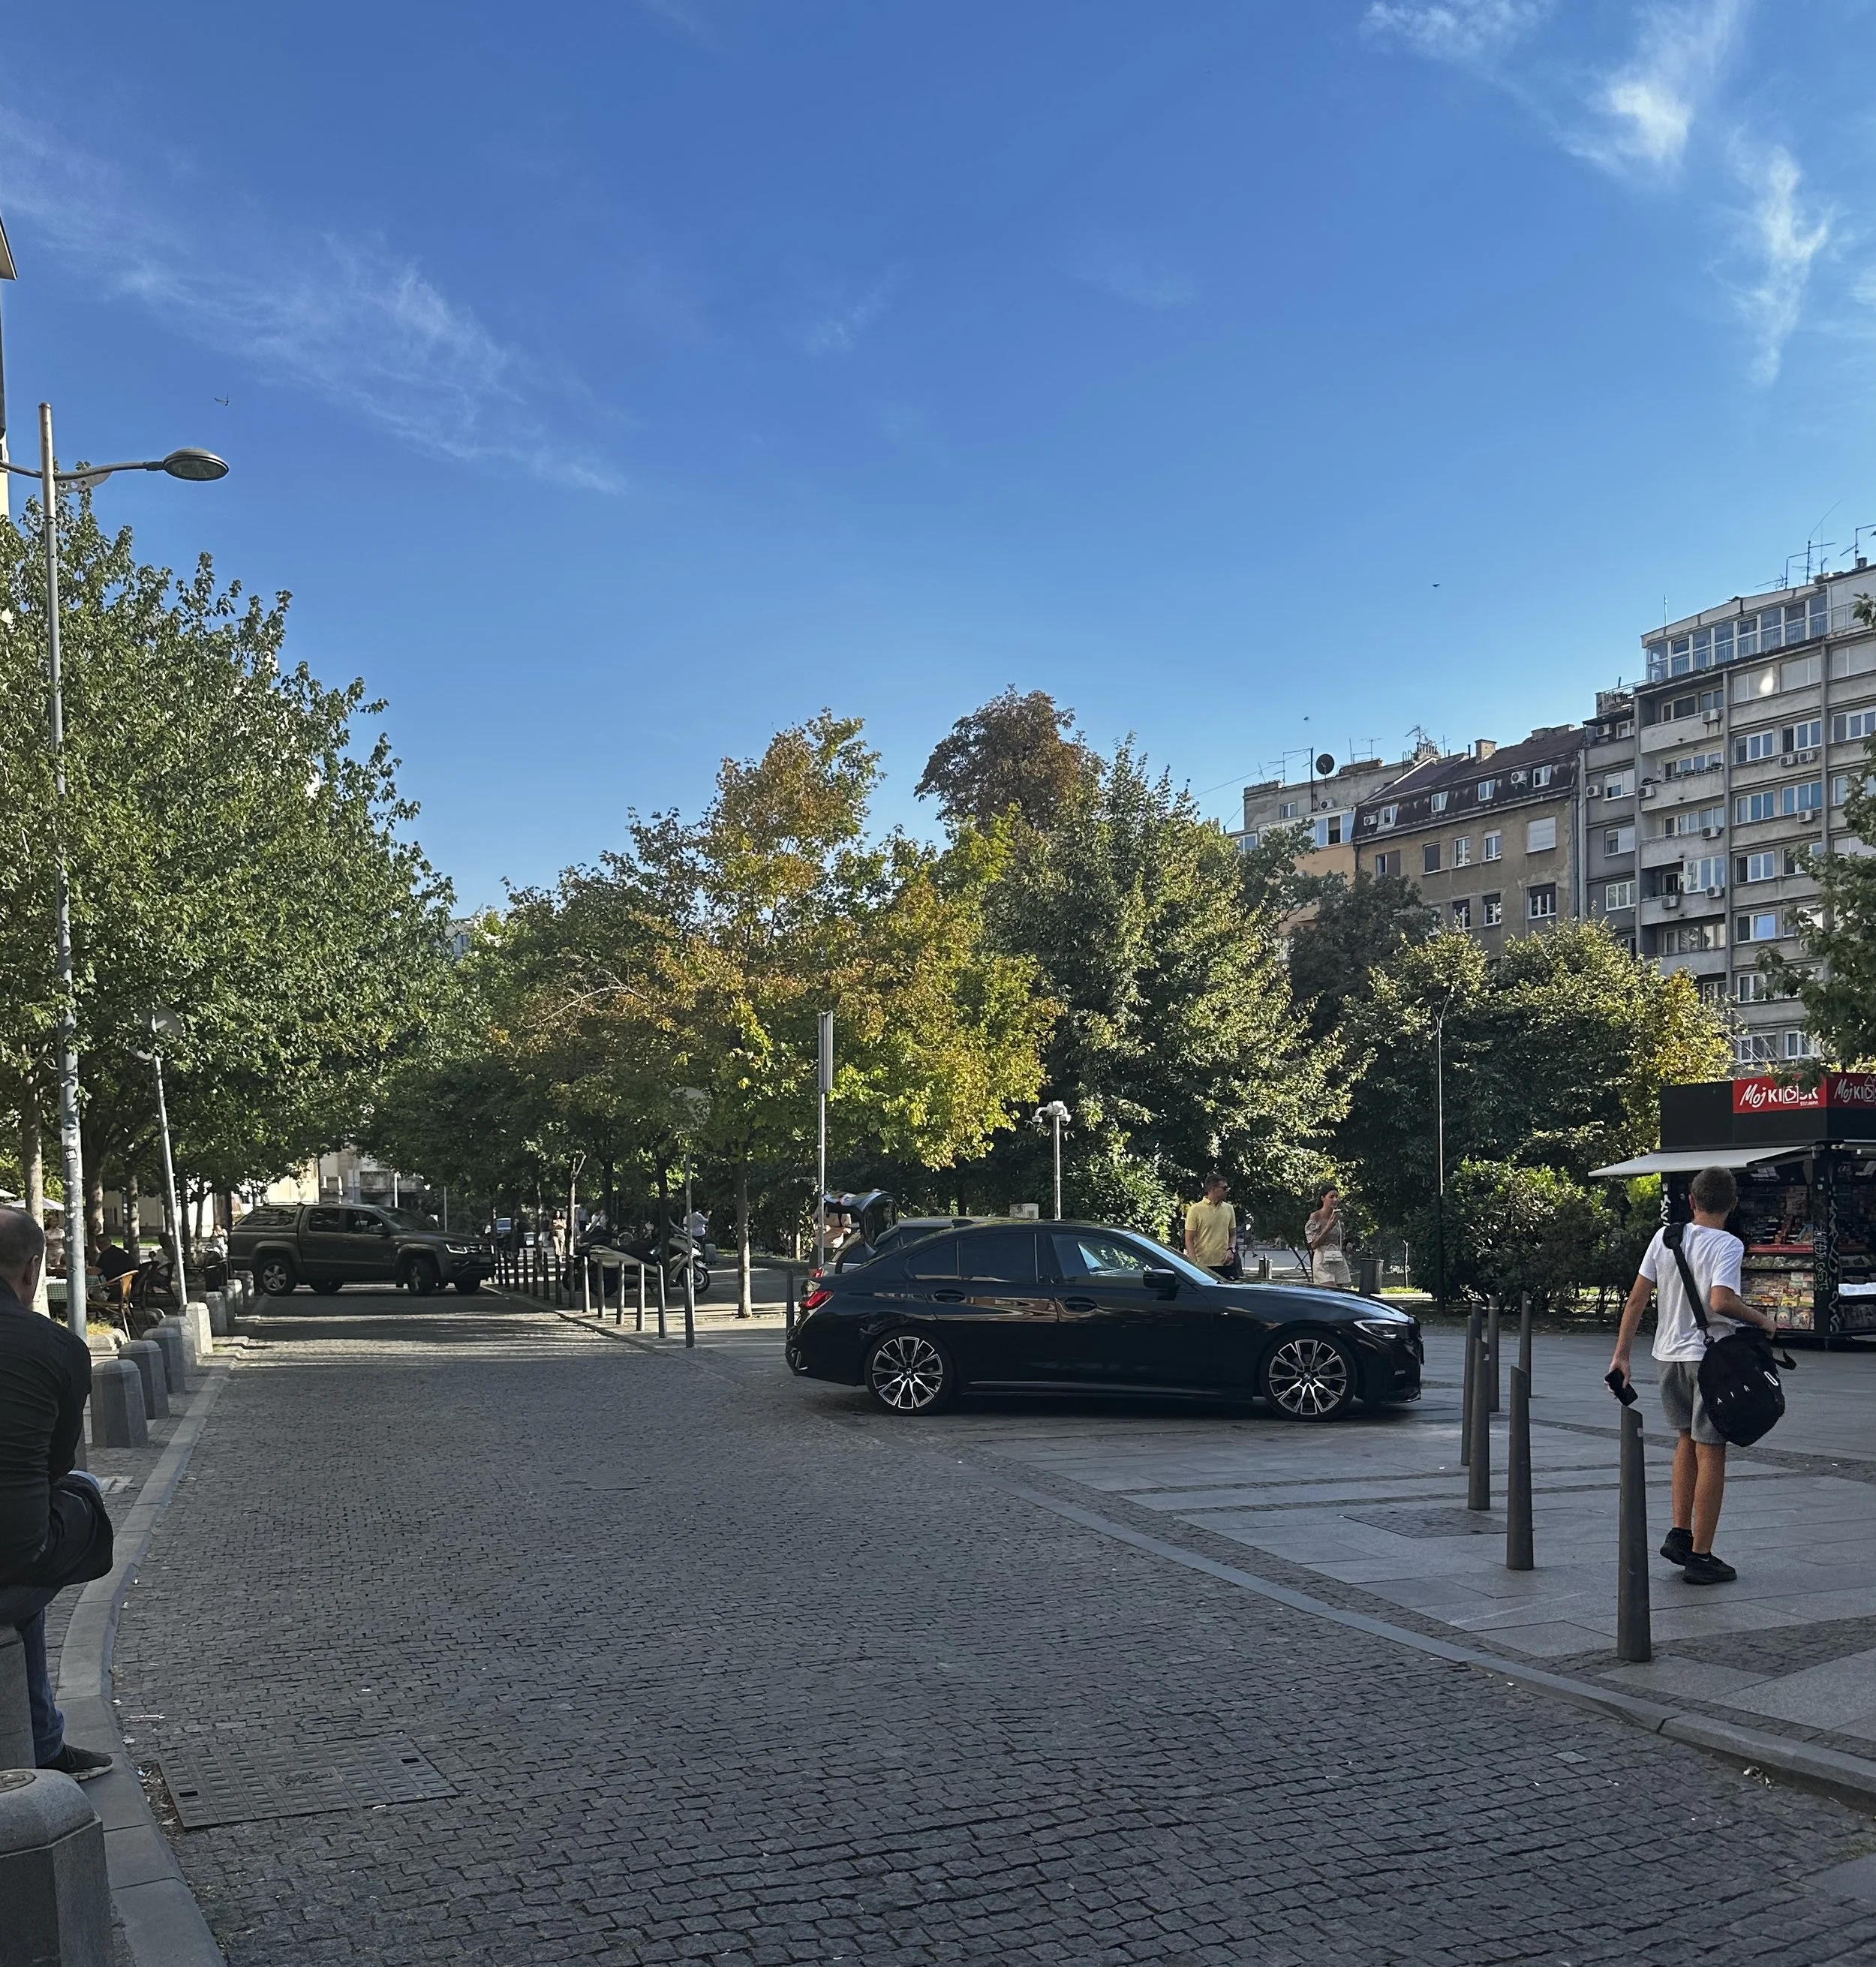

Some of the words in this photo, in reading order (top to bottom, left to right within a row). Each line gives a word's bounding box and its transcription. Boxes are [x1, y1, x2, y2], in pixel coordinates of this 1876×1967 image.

[1739, 1083, 1767, 1108] Moj
[1833, 1078, 1853, 1103] Moj
[1717, 1385, 1750, 1405] AIR
